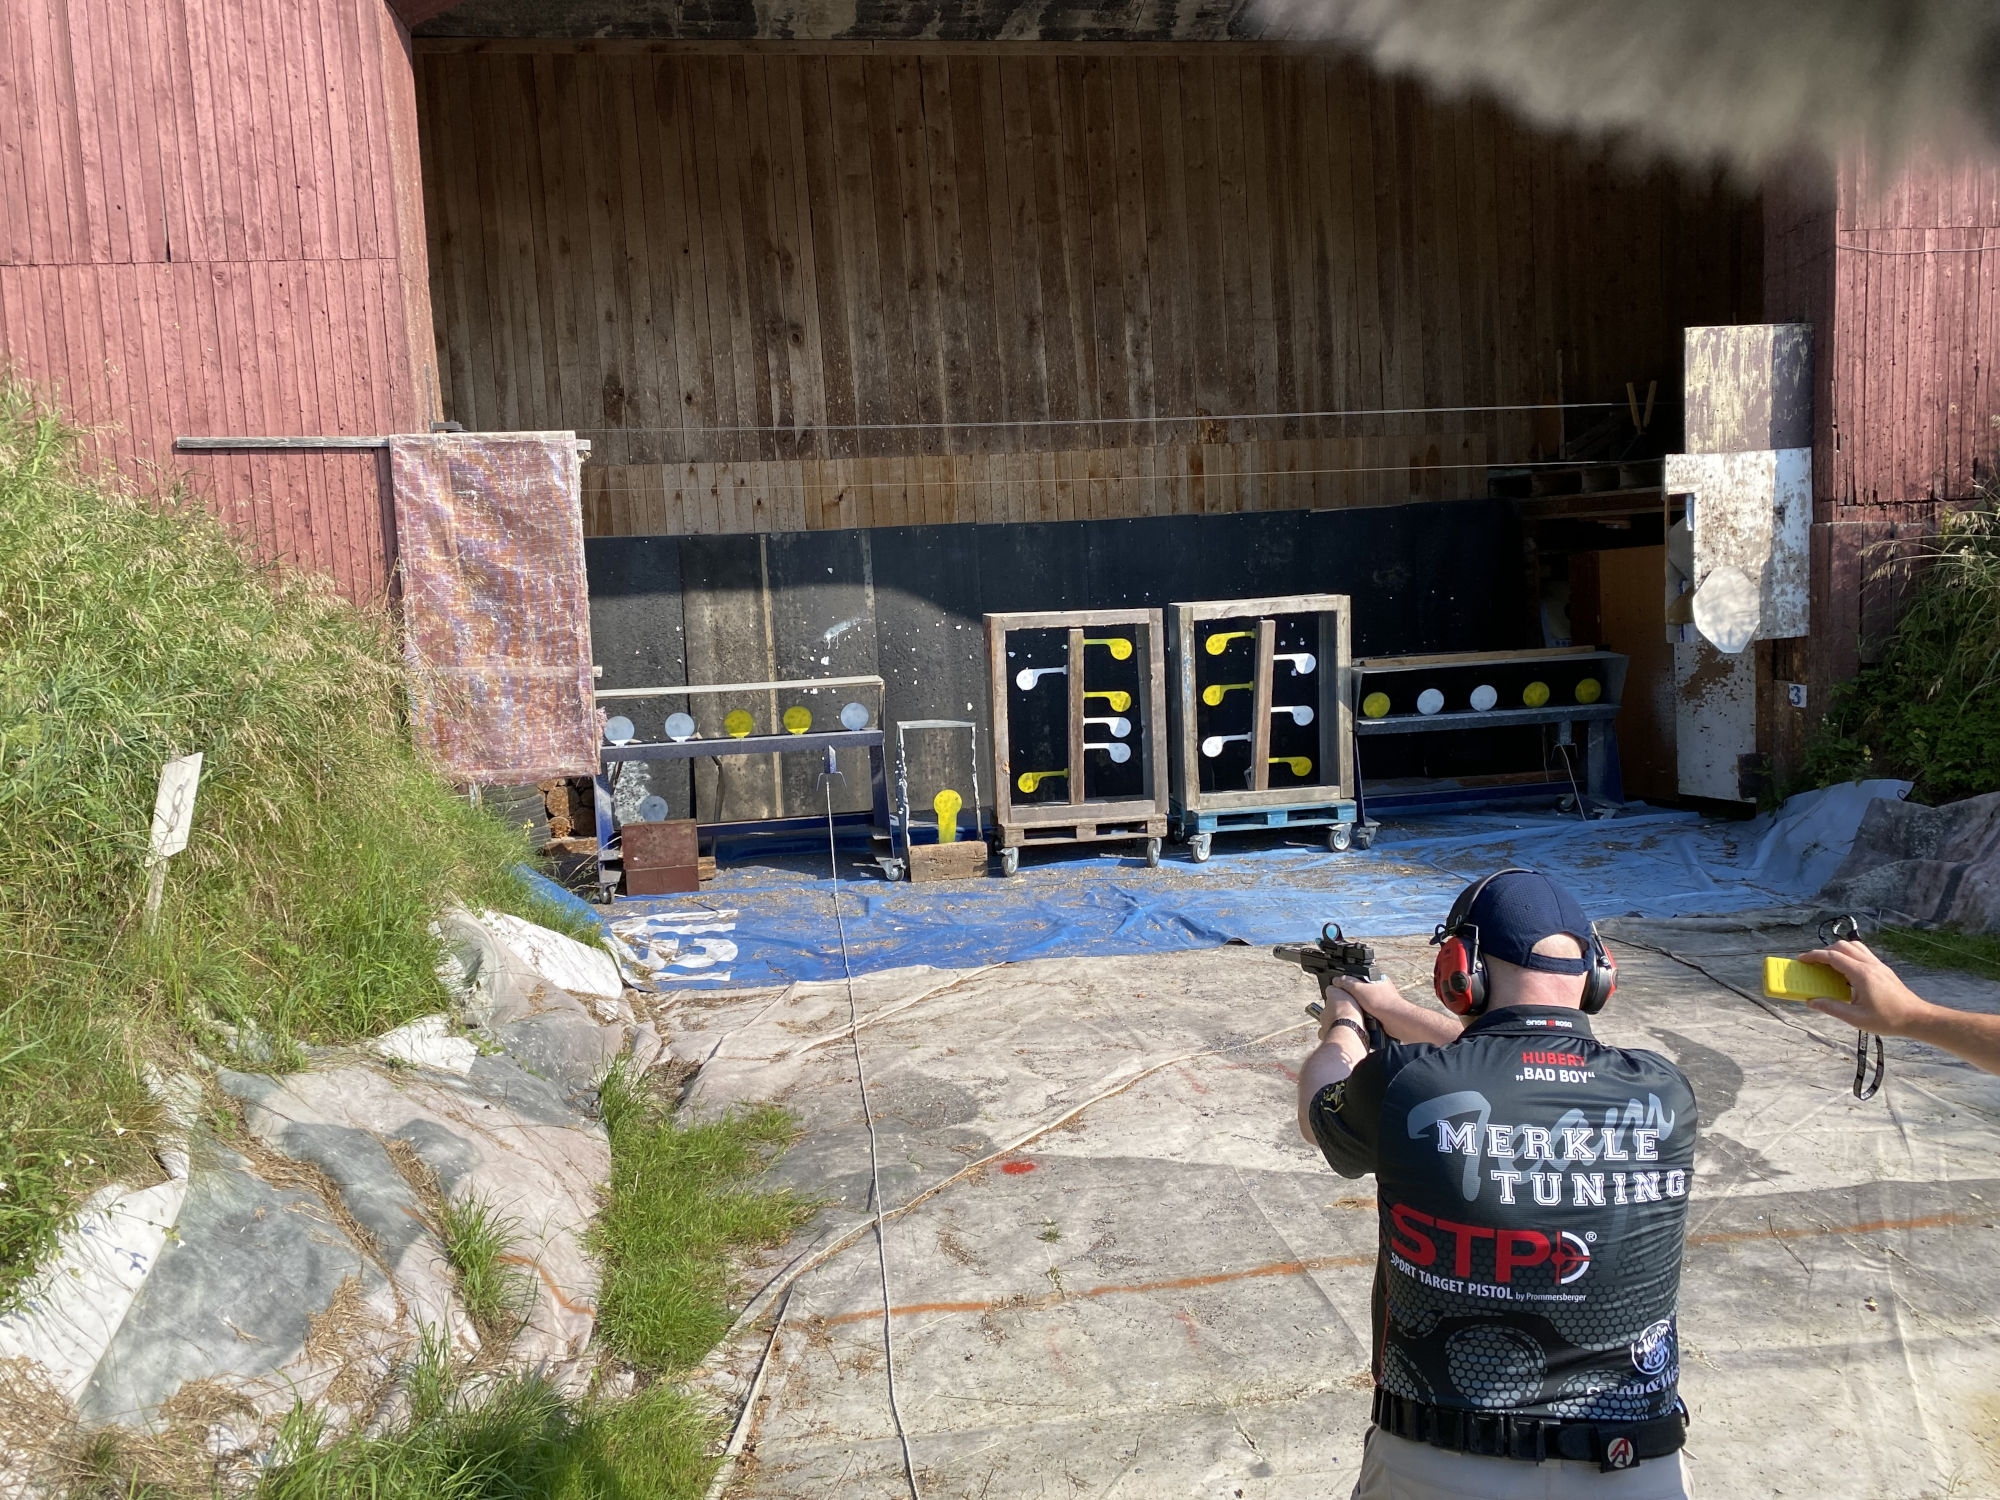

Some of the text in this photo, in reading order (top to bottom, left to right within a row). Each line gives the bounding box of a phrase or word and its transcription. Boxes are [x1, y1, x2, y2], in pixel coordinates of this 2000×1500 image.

[1791, 686, 1802, 705] 3
[1522, 1051, 1586, 1067] HUBERT
[1407, 1090, 1675, 1202] Team
[1437, 1120, 1660, 1160] MERKLE
[1490, 1168, 1686, 1206] TUNING
[1390, 1252, 1587, 1303] SPORT TARGET PISTOL by Prommersberger
